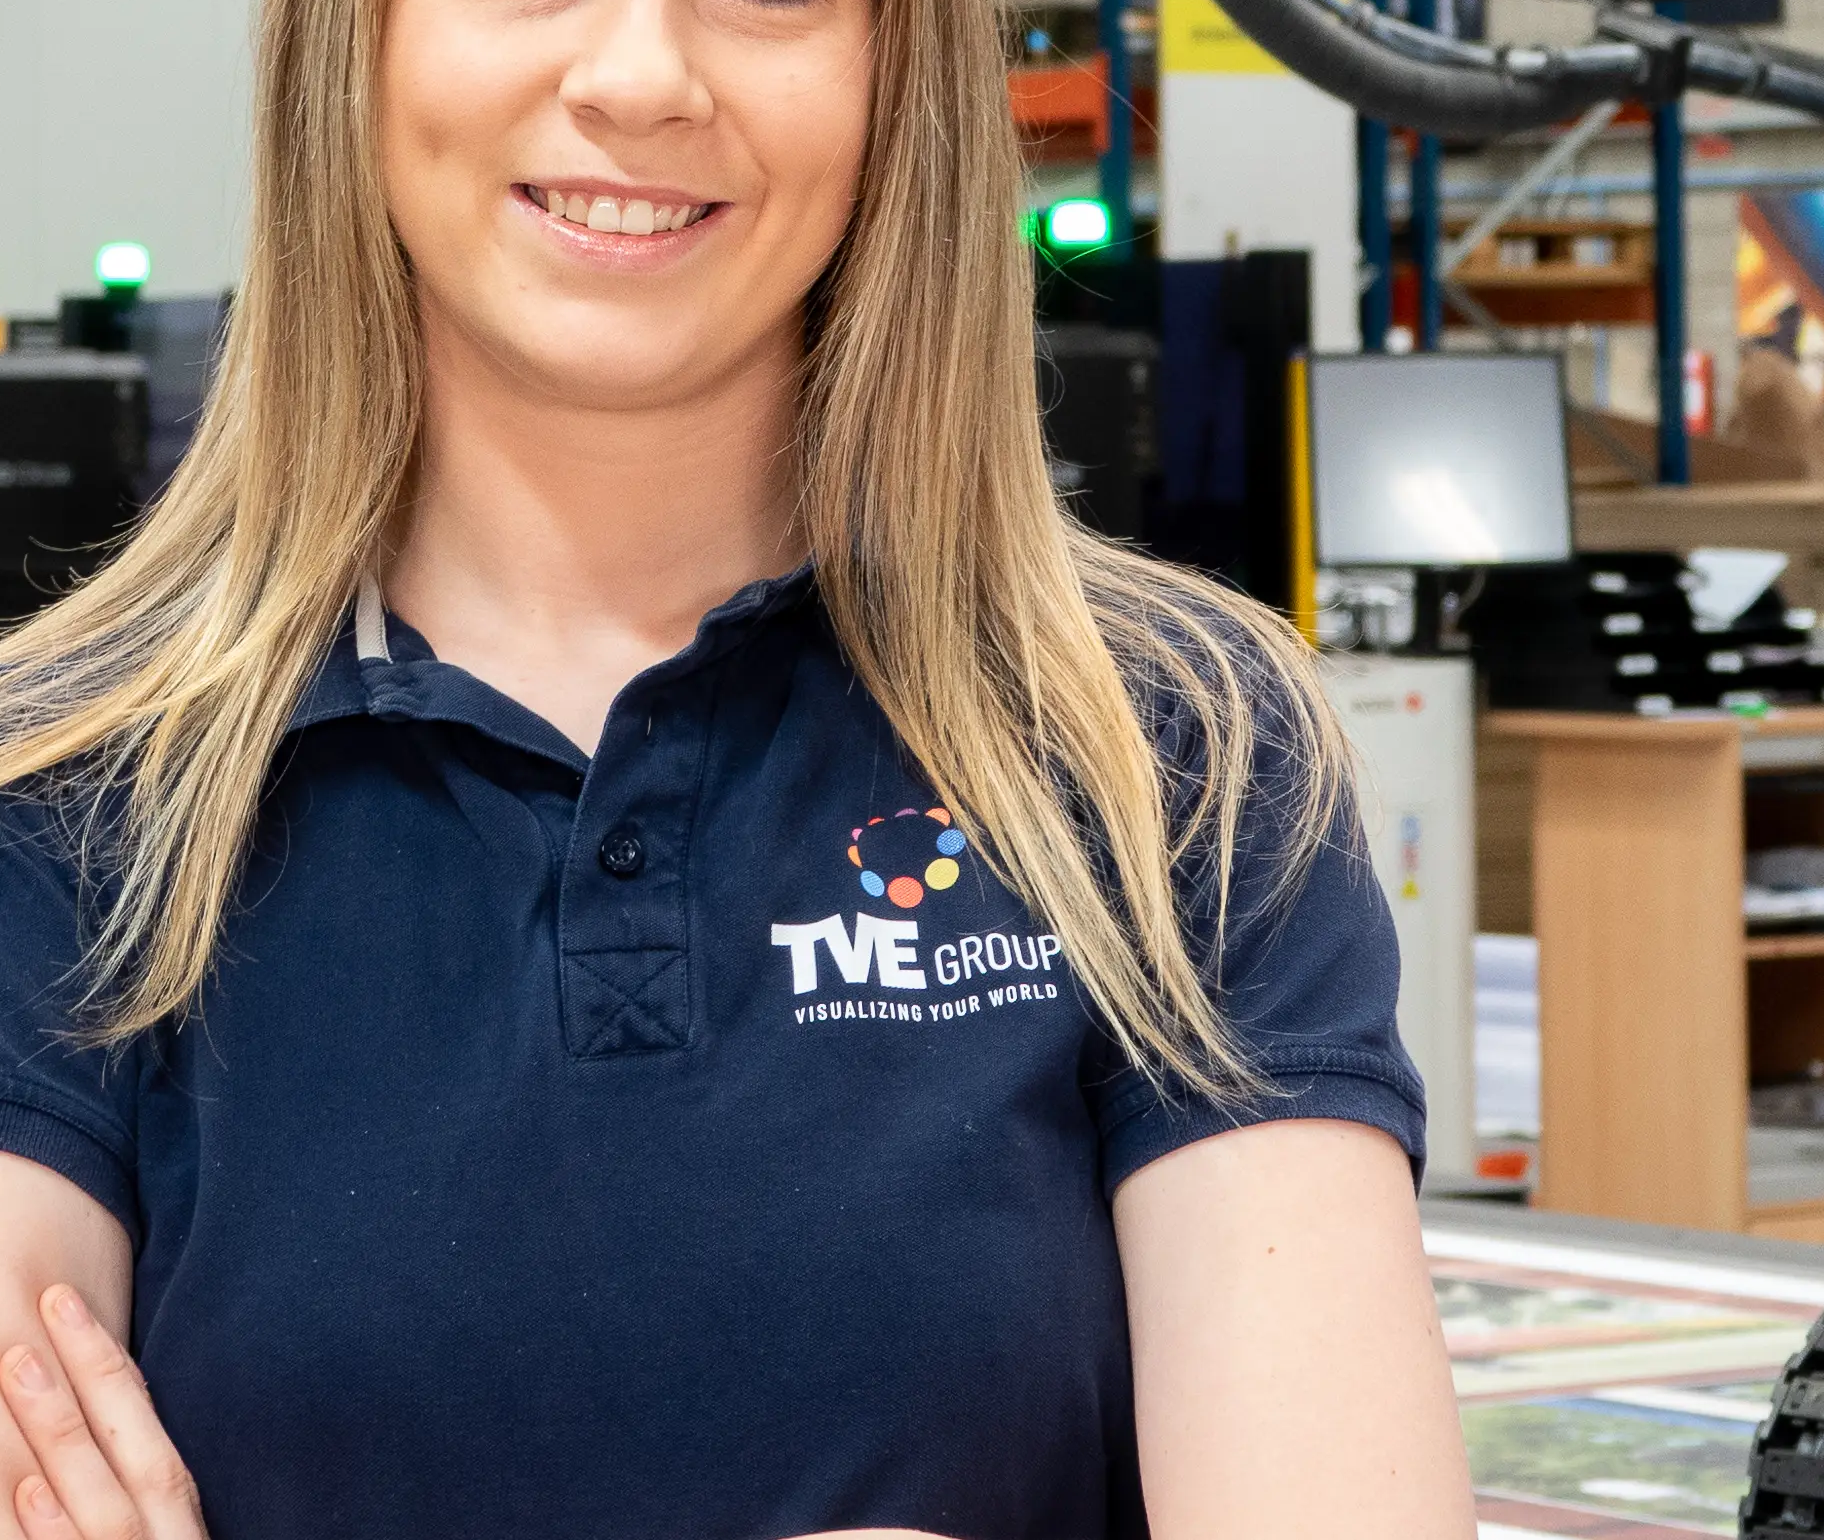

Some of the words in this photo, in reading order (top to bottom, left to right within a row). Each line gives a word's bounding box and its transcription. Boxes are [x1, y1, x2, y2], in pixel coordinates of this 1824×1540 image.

[771, 912, 927, 995] TVE
[934, 933, 1062, 986] GROUP
[795, 1000, 923, 1025] VISUALIZING
[929, 995, 980, 1022] YOUR
[988, 983, 1058, 1007] WORLD
